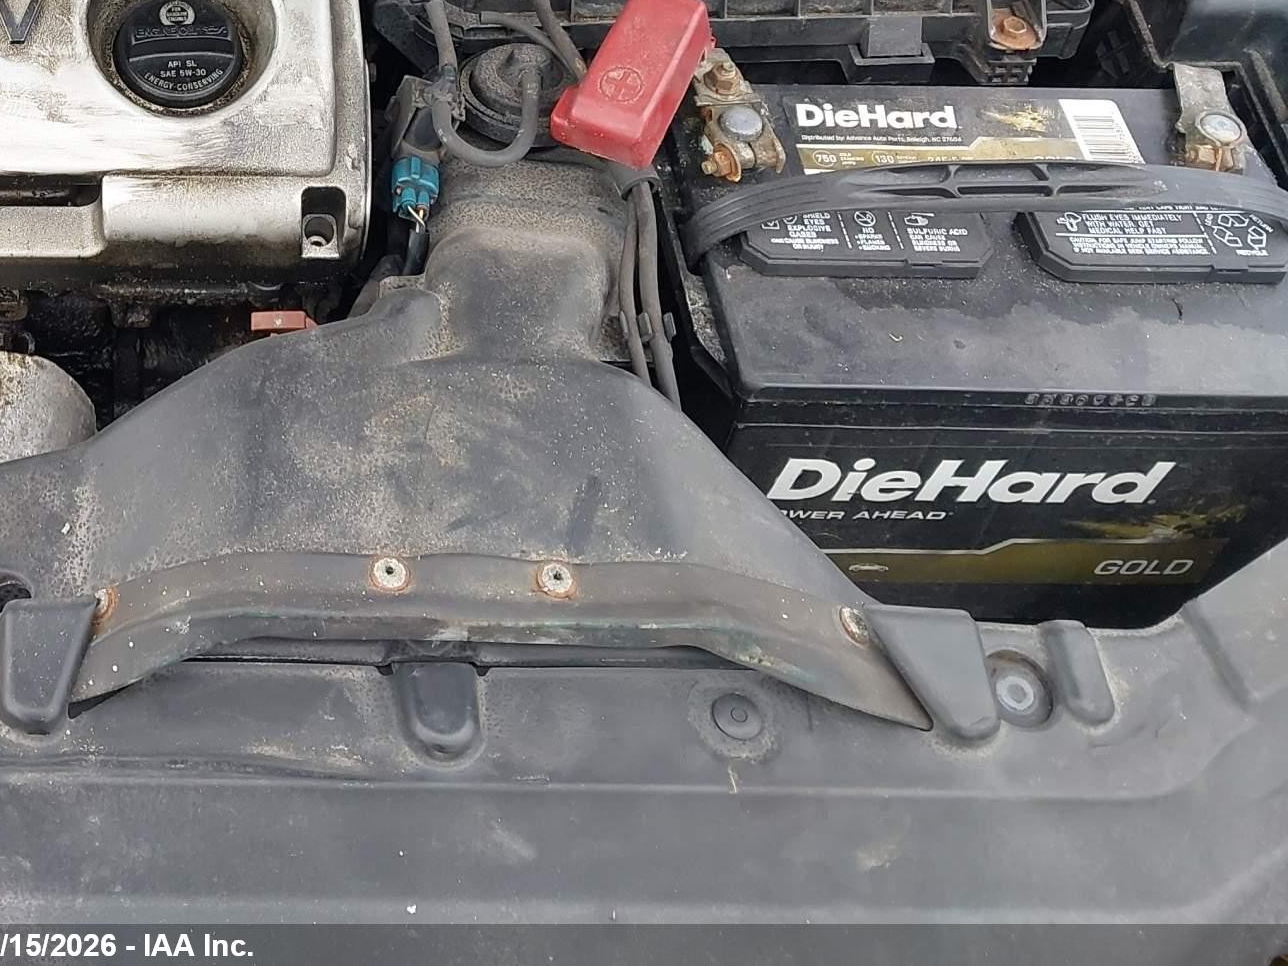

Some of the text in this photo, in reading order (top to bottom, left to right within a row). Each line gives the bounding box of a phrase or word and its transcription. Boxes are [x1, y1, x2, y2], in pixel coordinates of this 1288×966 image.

[168, 59, 198, 68] API SL
[160, 68, 207, 78] SAE 5W-30
[795, 103, 959, 129] DieHard
[815, 154, 837, 163] 750
[874, 155, 894, 164] 130
[787, 224, 832, 232] EXPLOSIVE
[949, 228, 968, 236] ACID
[766, 457, 1177, 504] DieHard
[852, 510, 947, 521] AHEAD
[1093, 559, 1194, 575] GOLD
